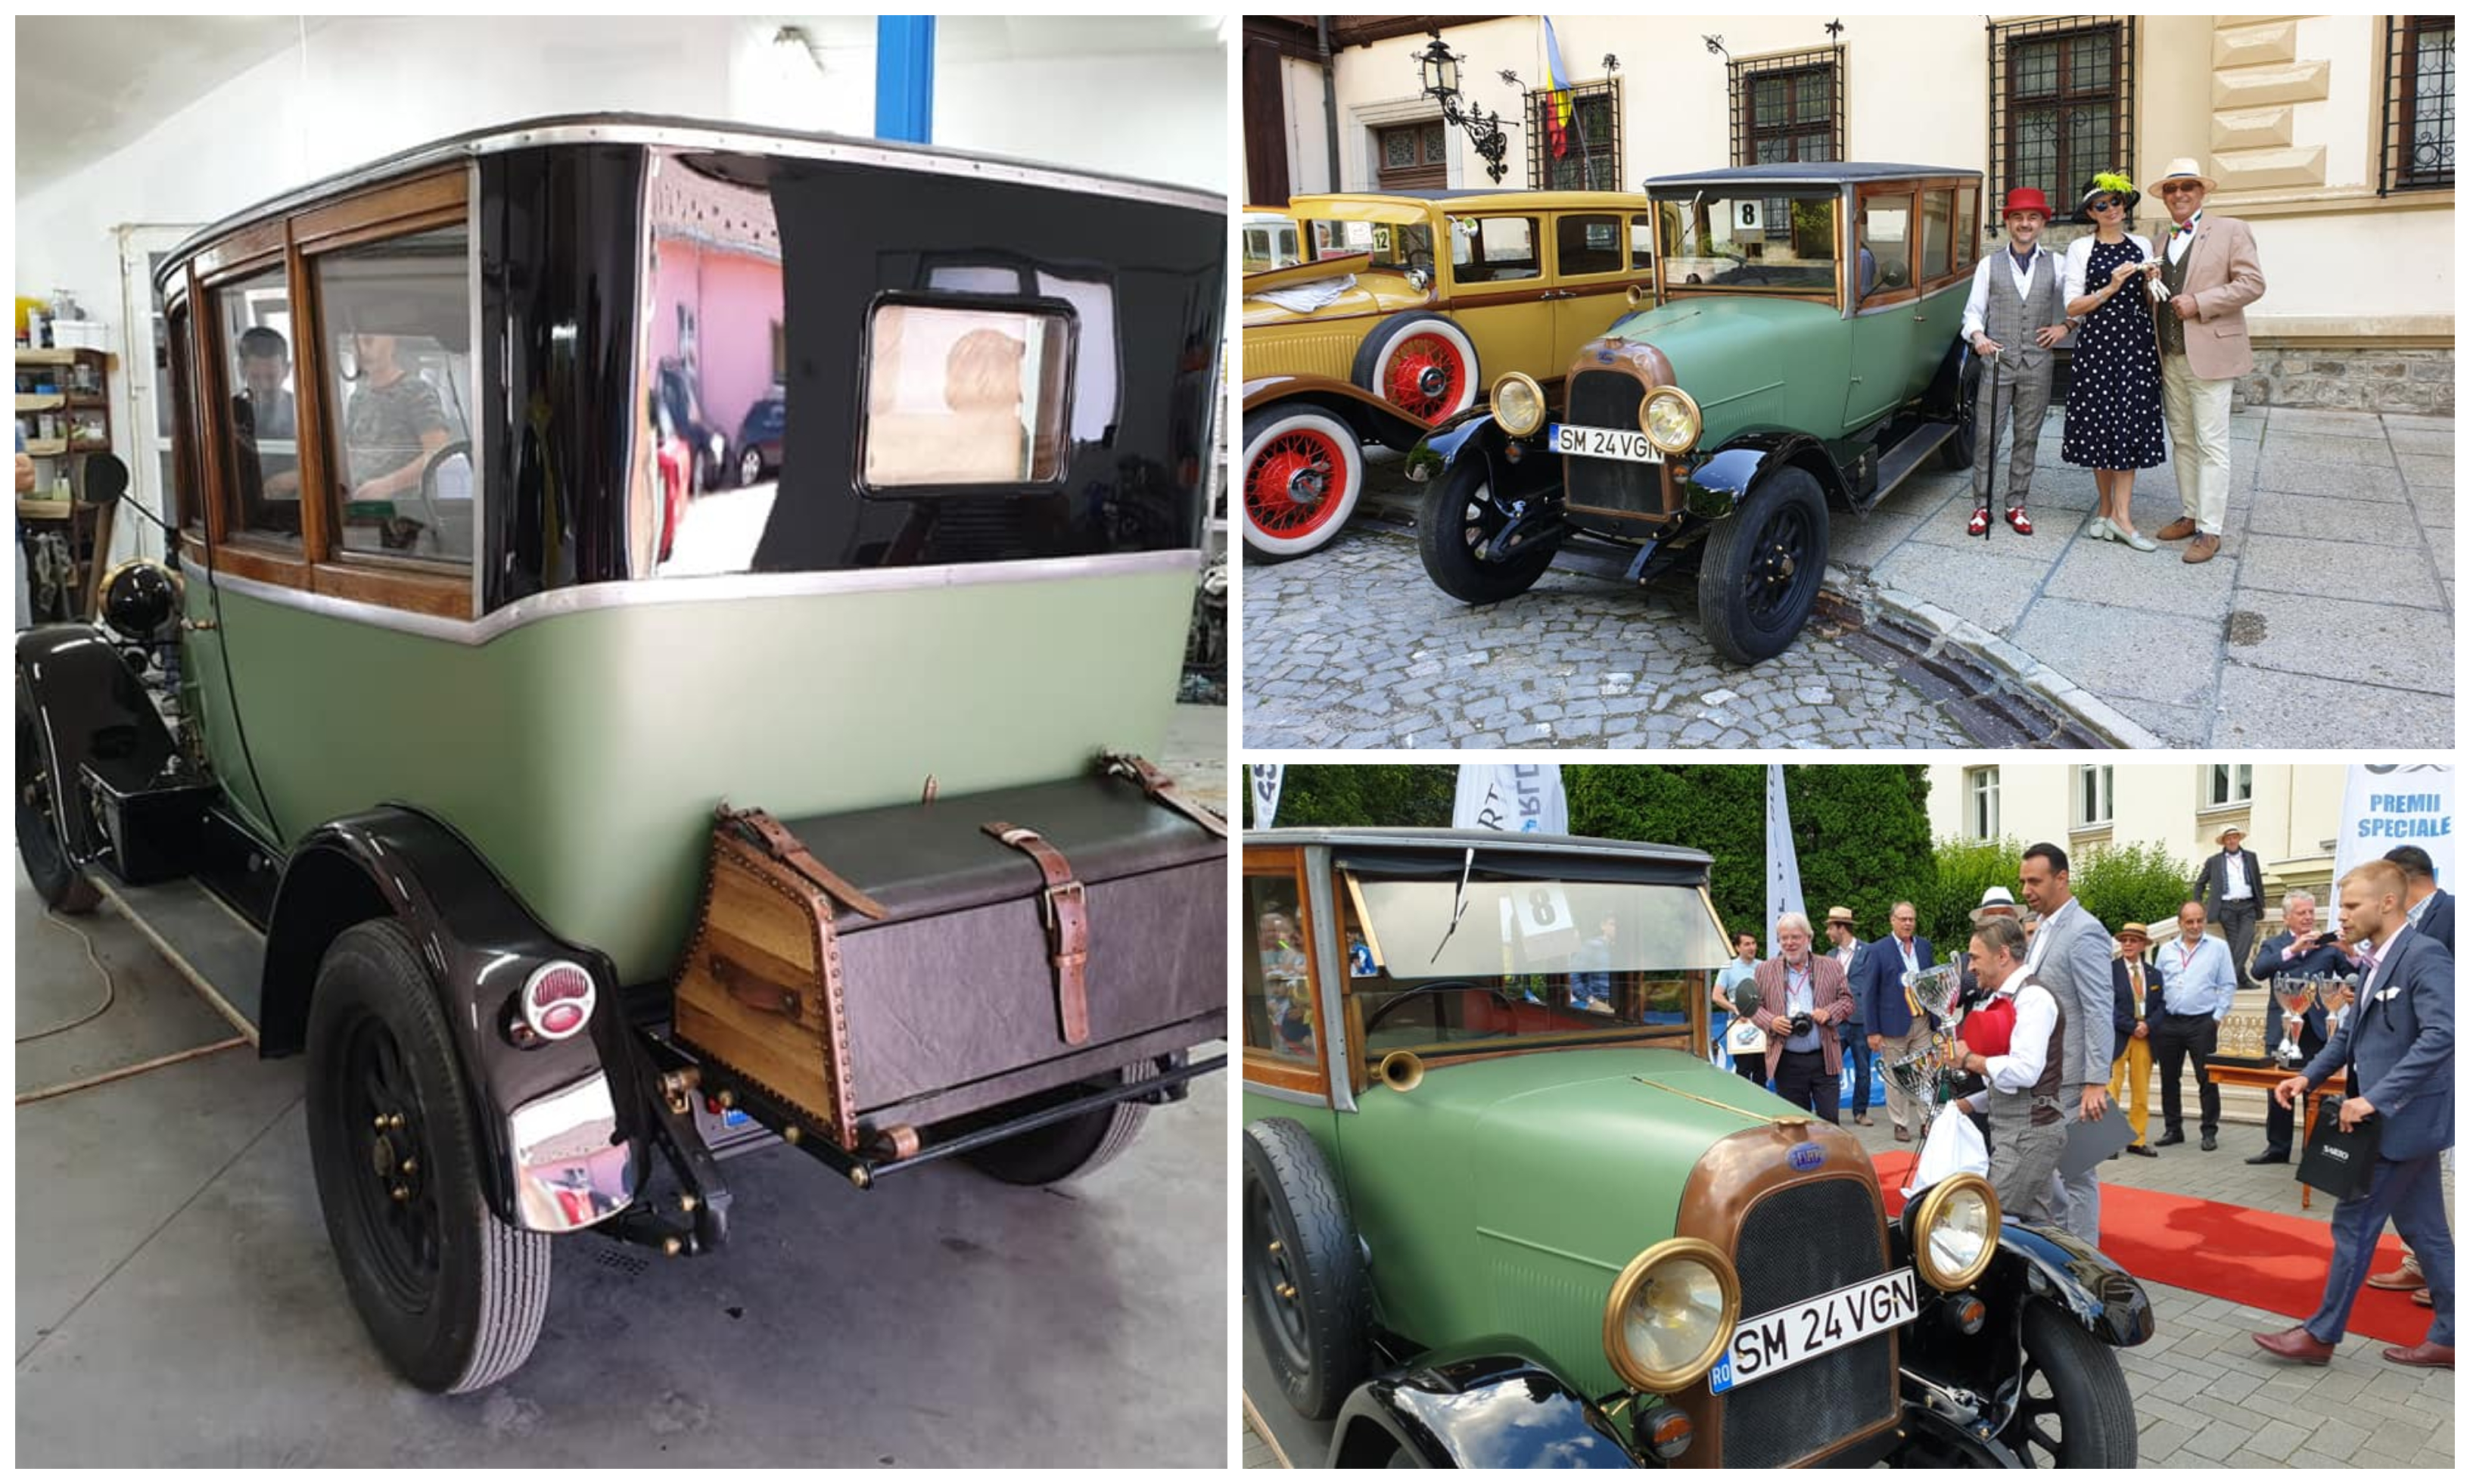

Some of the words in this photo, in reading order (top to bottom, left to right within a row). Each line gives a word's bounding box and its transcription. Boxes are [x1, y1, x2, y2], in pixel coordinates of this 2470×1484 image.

[1742, 203, 1755, 225] 8
[1374, 231, 1388, 249] 12
[1560, 429, 1587, 453] SM
[1594, 432, 1616, 455] 24
[2370, 793, 2440, 813] PREMII
[2358, 816, 2451, 838] SPECIALE
[1529, 888, 1556, 926] 8
[1712, 1366, 1730, 1386] RO
[1734, 1318, 1788, 1374] SM
[1801, 1300, 1843, 1352] 24
[1846, 1275, 1915, 1332] VGN
